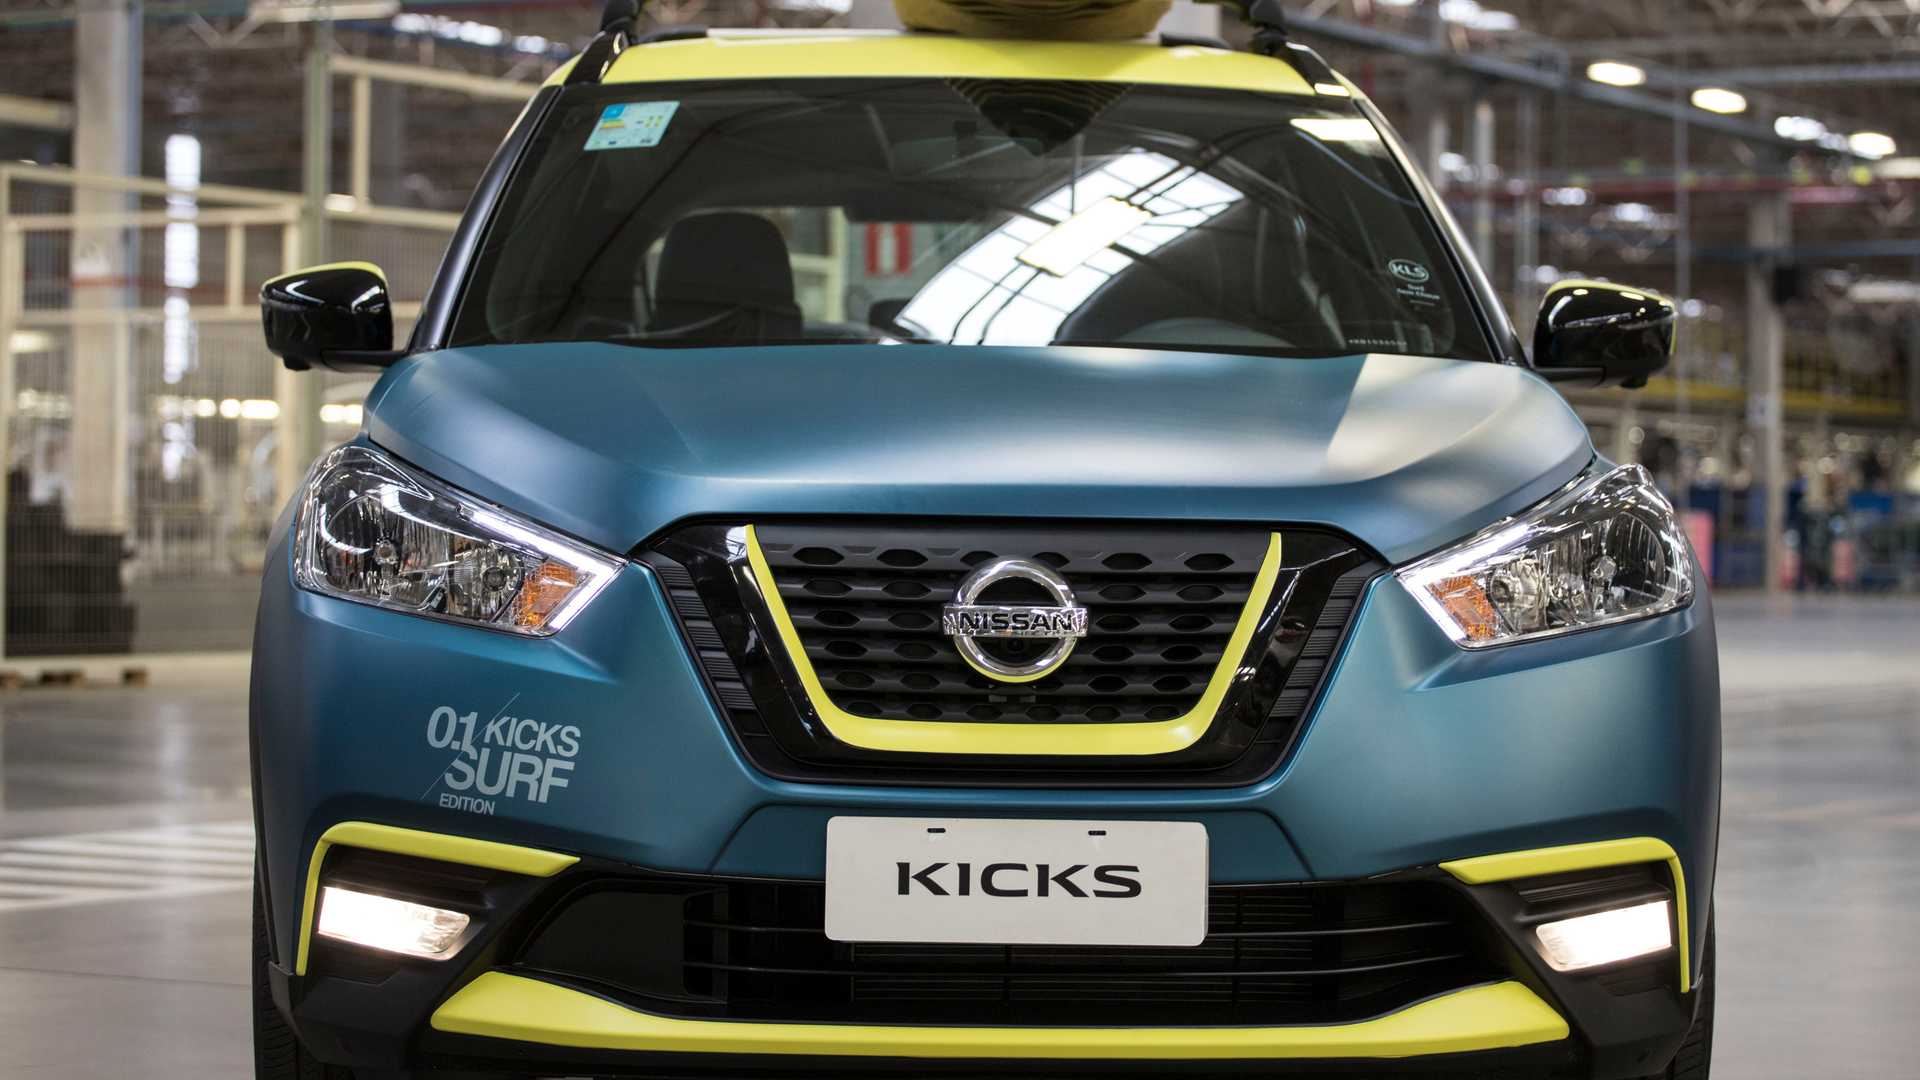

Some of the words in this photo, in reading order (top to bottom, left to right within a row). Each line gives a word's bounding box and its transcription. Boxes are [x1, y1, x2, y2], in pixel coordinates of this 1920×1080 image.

[958, 612, 1073, 631] NISSAN
[484, 716, 581, 758] KICKS
[444, 743, 575, 804] SURF
[439, 792, 496, 816] EDITION
[896, 862, 1142, 898] KICKS
